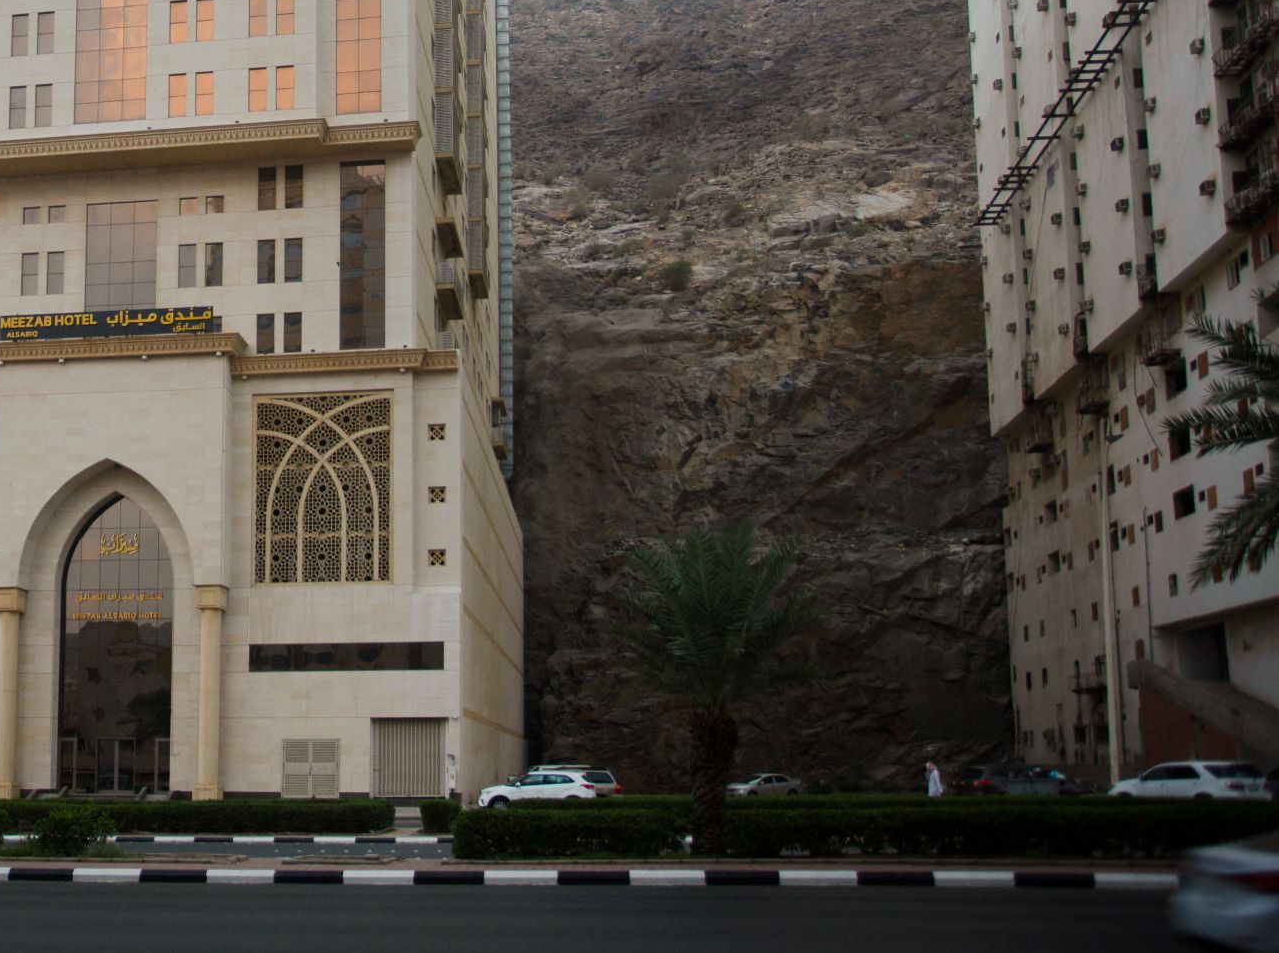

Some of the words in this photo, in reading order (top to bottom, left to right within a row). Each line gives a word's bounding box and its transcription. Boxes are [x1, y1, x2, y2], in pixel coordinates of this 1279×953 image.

[1, 316, 52, 328] MEEZAB
[54, 313, 97, 326] HOTEL
[106, 310, 158, 327] ميزاب
[160, 307, 212, 325] فندق
[172, 322, 205, 333] السابق
